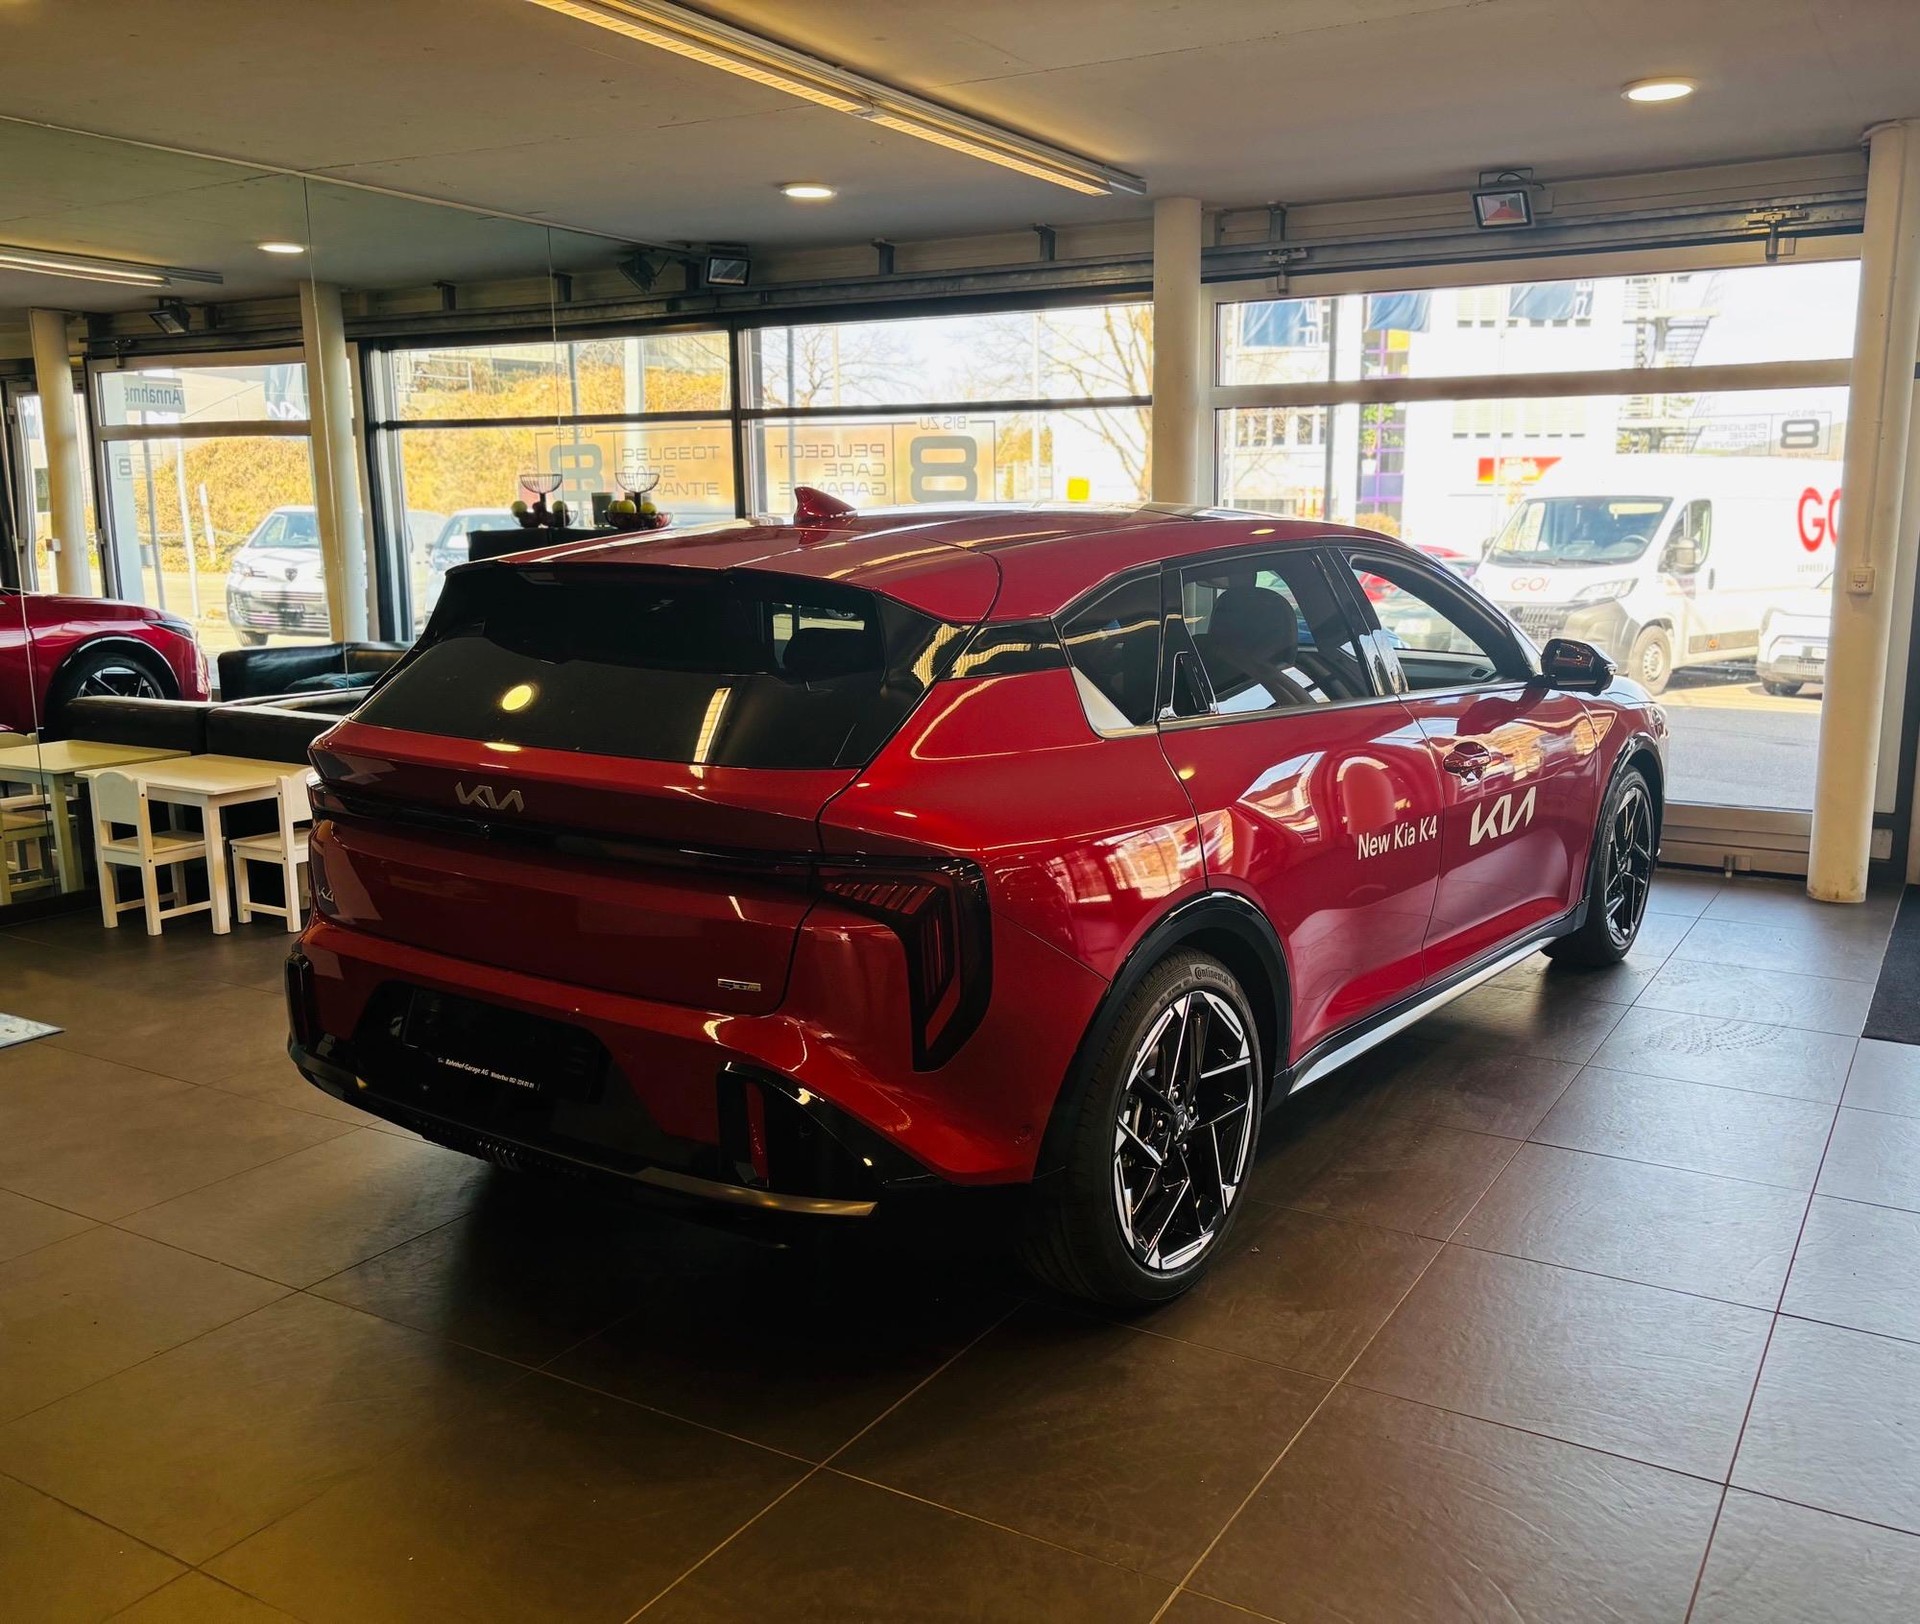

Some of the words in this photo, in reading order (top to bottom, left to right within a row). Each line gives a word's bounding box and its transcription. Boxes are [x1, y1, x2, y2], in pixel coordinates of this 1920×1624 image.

[622, 445, 720, 462] PEUGEOT
[1511, 576, 1551, 592] GO!
[454, 781, 525, 813] KIA
[1469, 786, 1537, 846] KIA
[1357, 832, 1391, 860] New
[1393, 822, 1416, 850] Kia
[1418, 815, 1438, 843] K4
